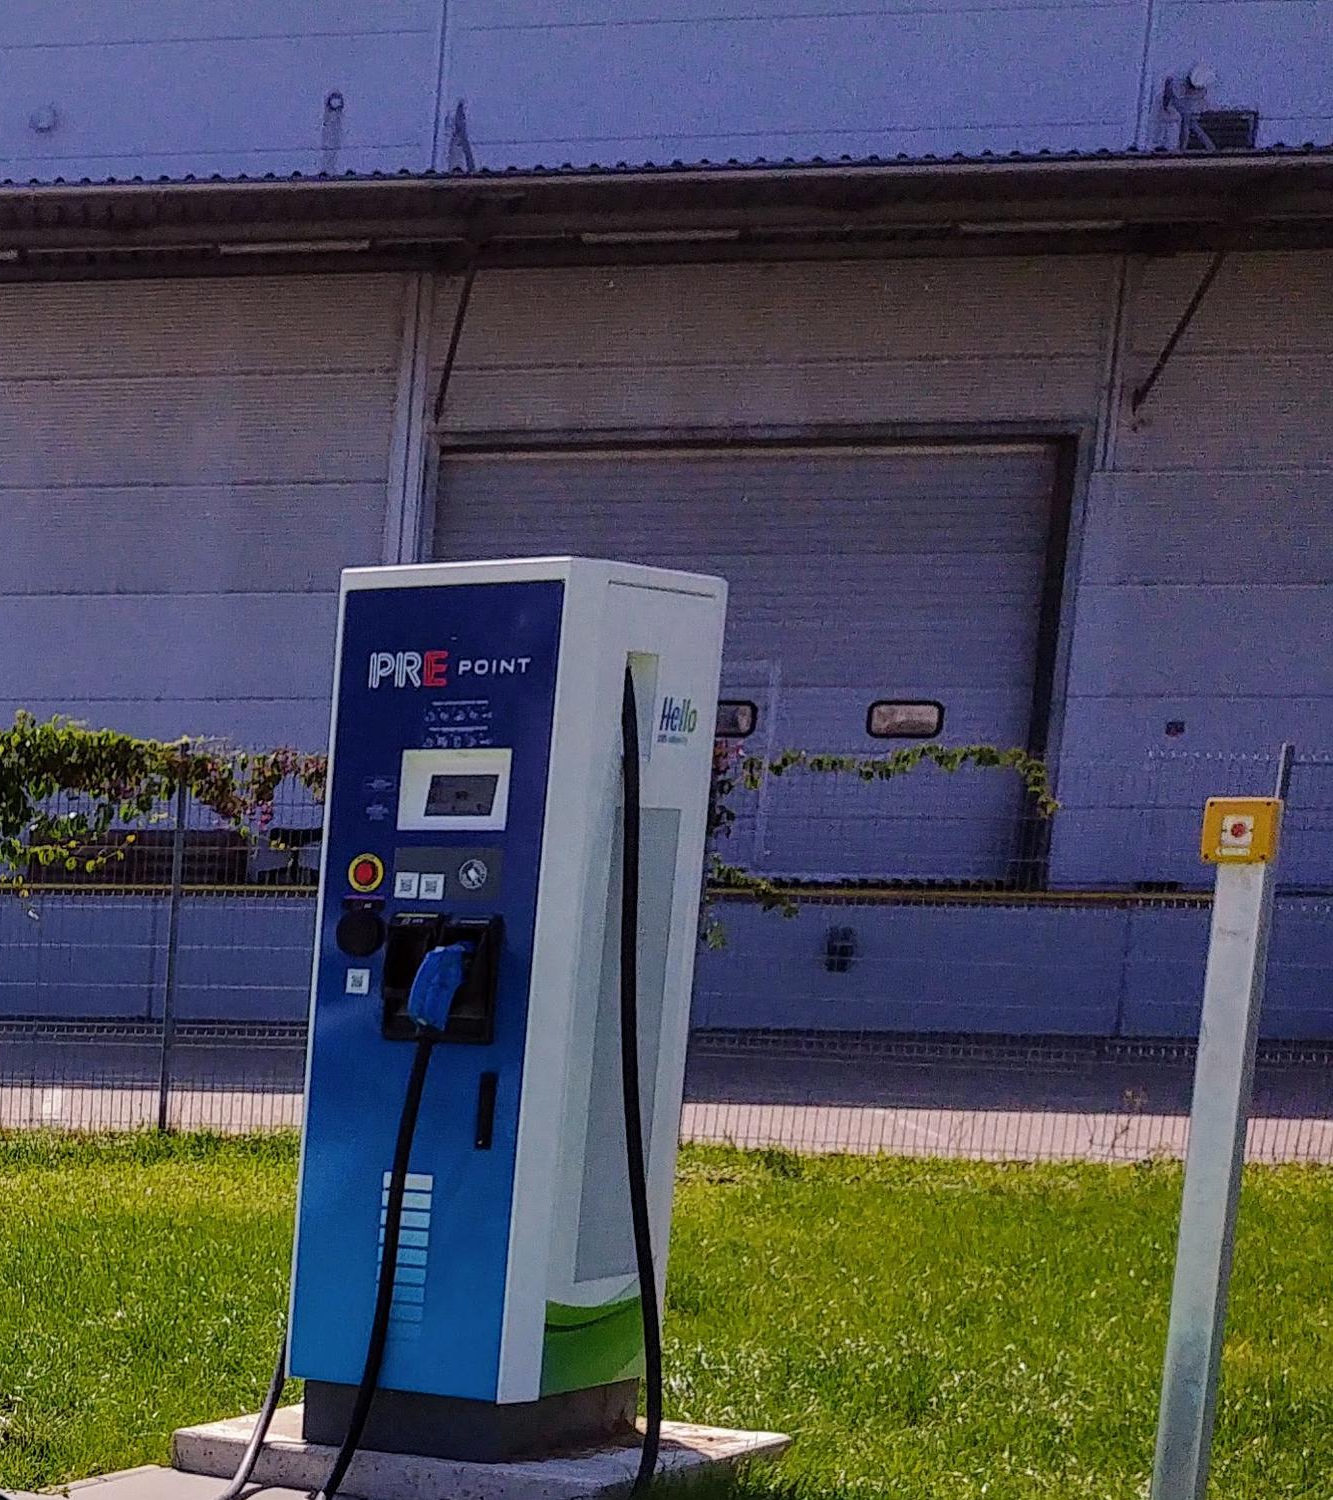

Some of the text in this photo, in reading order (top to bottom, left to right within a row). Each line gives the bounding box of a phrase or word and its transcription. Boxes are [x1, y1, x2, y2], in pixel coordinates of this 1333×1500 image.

[367, 650, 531, 688] PRE POINT
[659, 696, 697, 732] Hello
